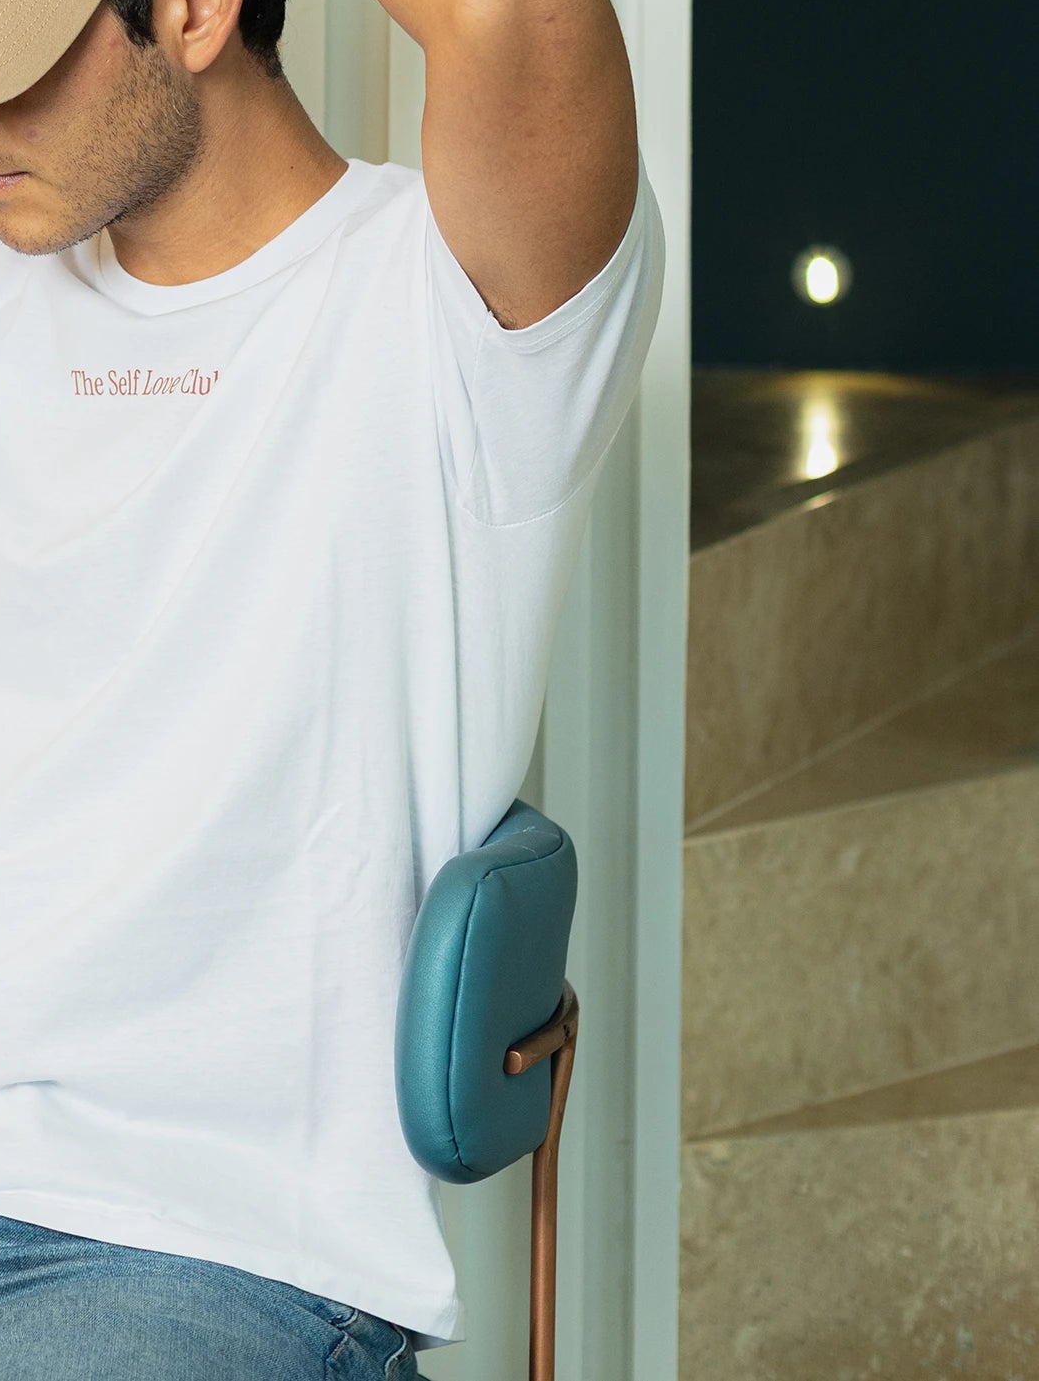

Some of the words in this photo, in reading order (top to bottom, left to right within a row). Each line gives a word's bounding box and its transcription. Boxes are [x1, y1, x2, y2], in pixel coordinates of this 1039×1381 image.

[71, 370, 104, 396] The
[108, 368, 141, 396] Self
[142, 369, 180, 396] Love
